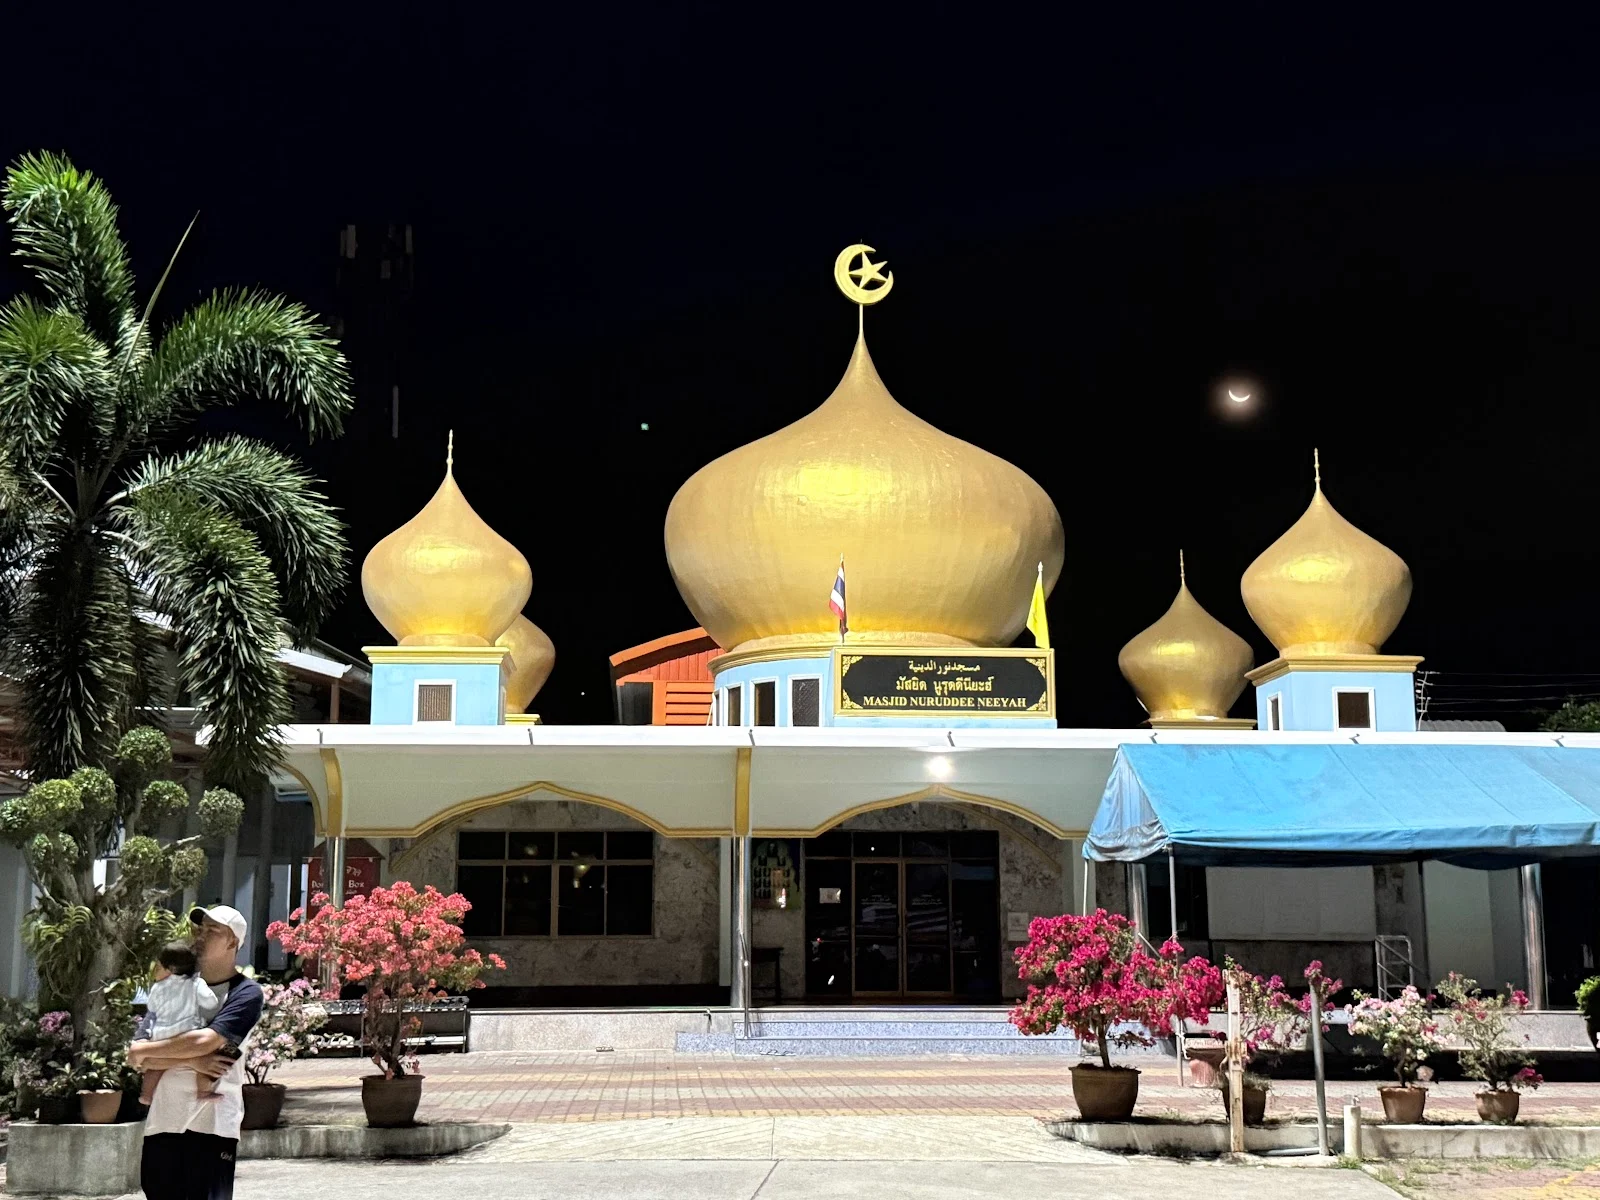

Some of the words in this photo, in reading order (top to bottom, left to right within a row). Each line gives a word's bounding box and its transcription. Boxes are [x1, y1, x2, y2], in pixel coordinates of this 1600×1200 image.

[895, 675, 927, 691] มัสยิด
[863, 695, 907, 707] MASJID
[909, 696, 975, 708] NURUDDEE
[978, 697, 1026, 708] NEEYAH
[348, 879, 365, 888] Box
